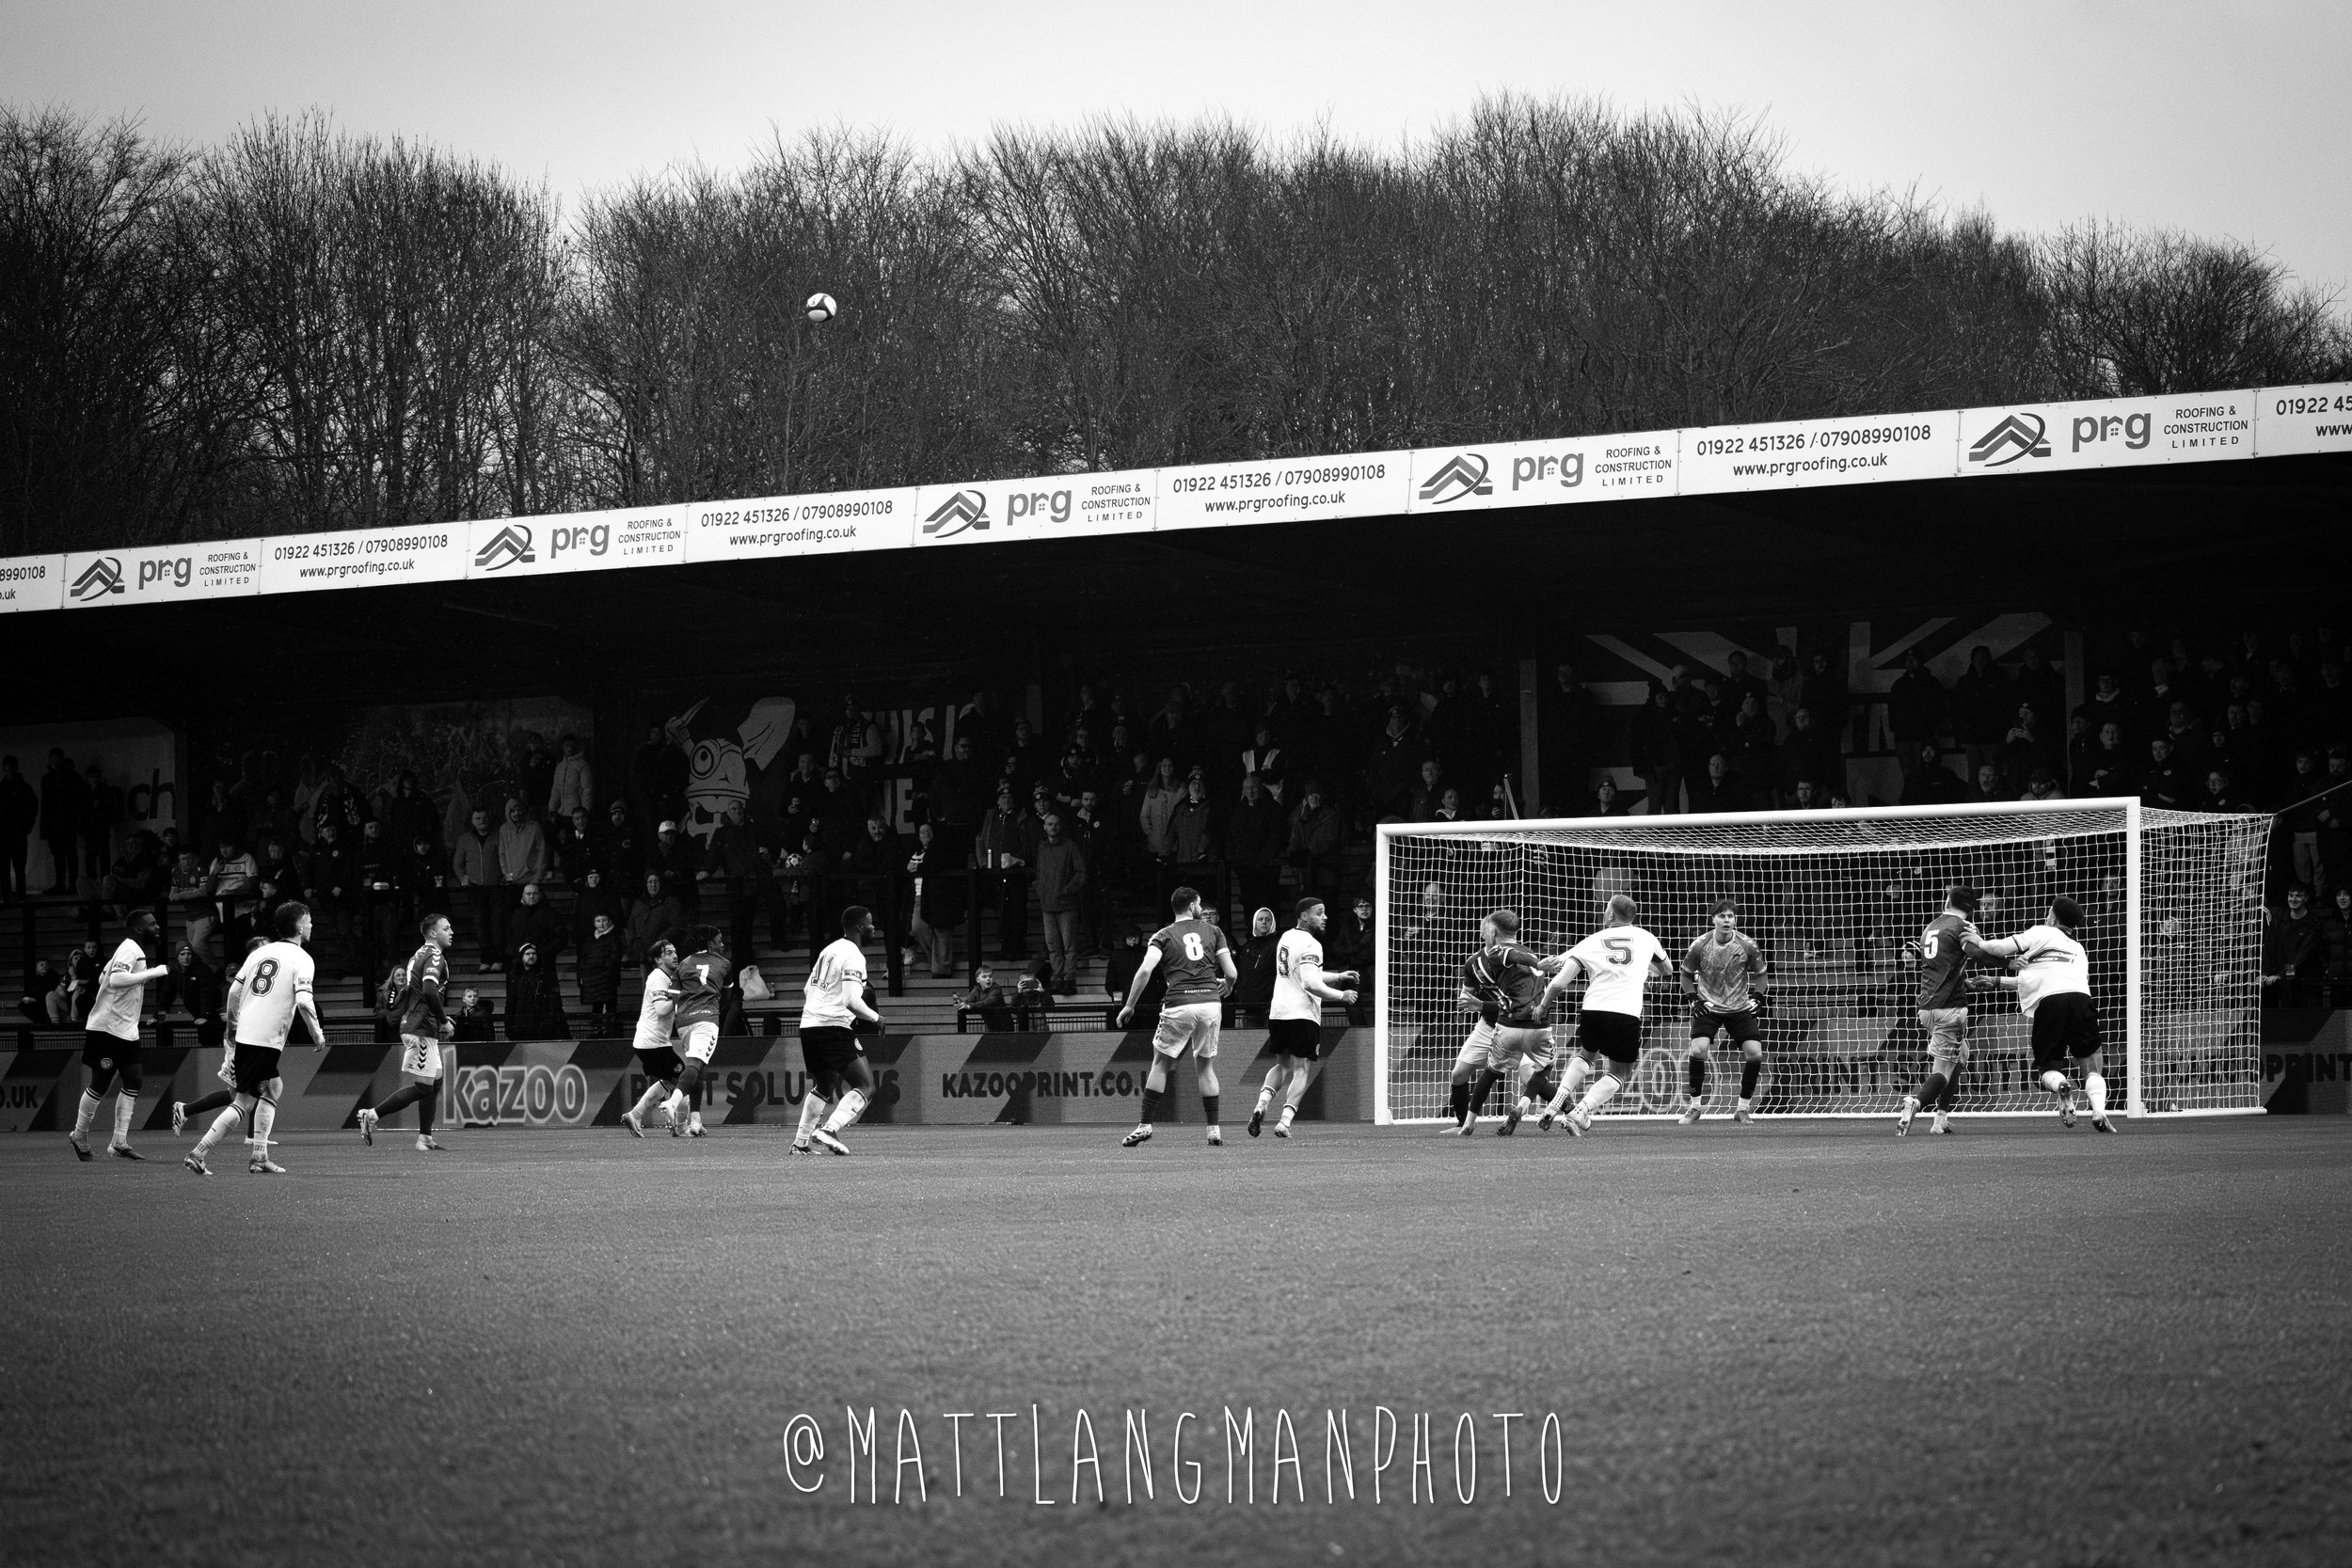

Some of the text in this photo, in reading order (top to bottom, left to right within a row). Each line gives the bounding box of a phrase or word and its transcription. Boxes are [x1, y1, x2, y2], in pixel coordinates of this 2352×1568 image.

[2175, 404, 2236, 420] ROOFING &
[2276, 396, 2328, 416] 01922
[2072, 412, 2152, 453] prg
[2163, 420, 2249, 436] CONSTRUCTION
[1696, 424, 1931, 456] 01922 451326 / 07908990108
[2171, 436, 2239, 449] LIMITED
[1606, 445, 1661, 459] ROOFING &
[1512, 452, 1584, 491] prg
[1595, 459, 1672, 474] CONSTRUCTION
[1733, 452, 1888, 477] www.prgroofing.co.uk
[1091, 483, 1141, 496] ROOFING &
[1173, 464, 1385, 494] 01922 451326 / 07908990108
[1602, 474, 1663, 486] LIMITED
[1007, 490, 1072, 526] prg
[1081, 497, 1151, 510] CONSTRUCTION
[1204, 490, 1345, 513] www.prgroofing.co.uk
[628, 517, 672, 530] ROOFING &
[701, 499, 893, 528] 01922 451326 / 07908990108
[1088, 511, 1143, 522] LIMITED
[550, 524, 610, 559] prg
[618, 531, 680, 544] CONSTRUCTION
[729, 525, 857, 546] www.prgroofing.co.uk
[207, 551, 248, 562] ROOFING &
[274, 534, 448, 561] 01922 451326 / 07908990108
[623, 545, 674, 554] LIMITED
[138, 557, 192, 591] prg
[199, 563, 256, 576] CONSTRUCTION
[299, 558, 415, 578] www.prgroofing.co.uk
[204, 577, 249, 587] LIMITED
[0, 588, 17, 601] .uk
[1183, 932, 1204, 961] 8
[1602, 938, 1633, 965] 5
[1924, 929, 1940, 959] 5
[1278, 944, 1290, 978] 9
[251, 958, 280, 997] 8
[696, 964, 709, 986] 7
[810, 954, 836, 991] 11
[442, 1044, 588, 1126] kazoo
